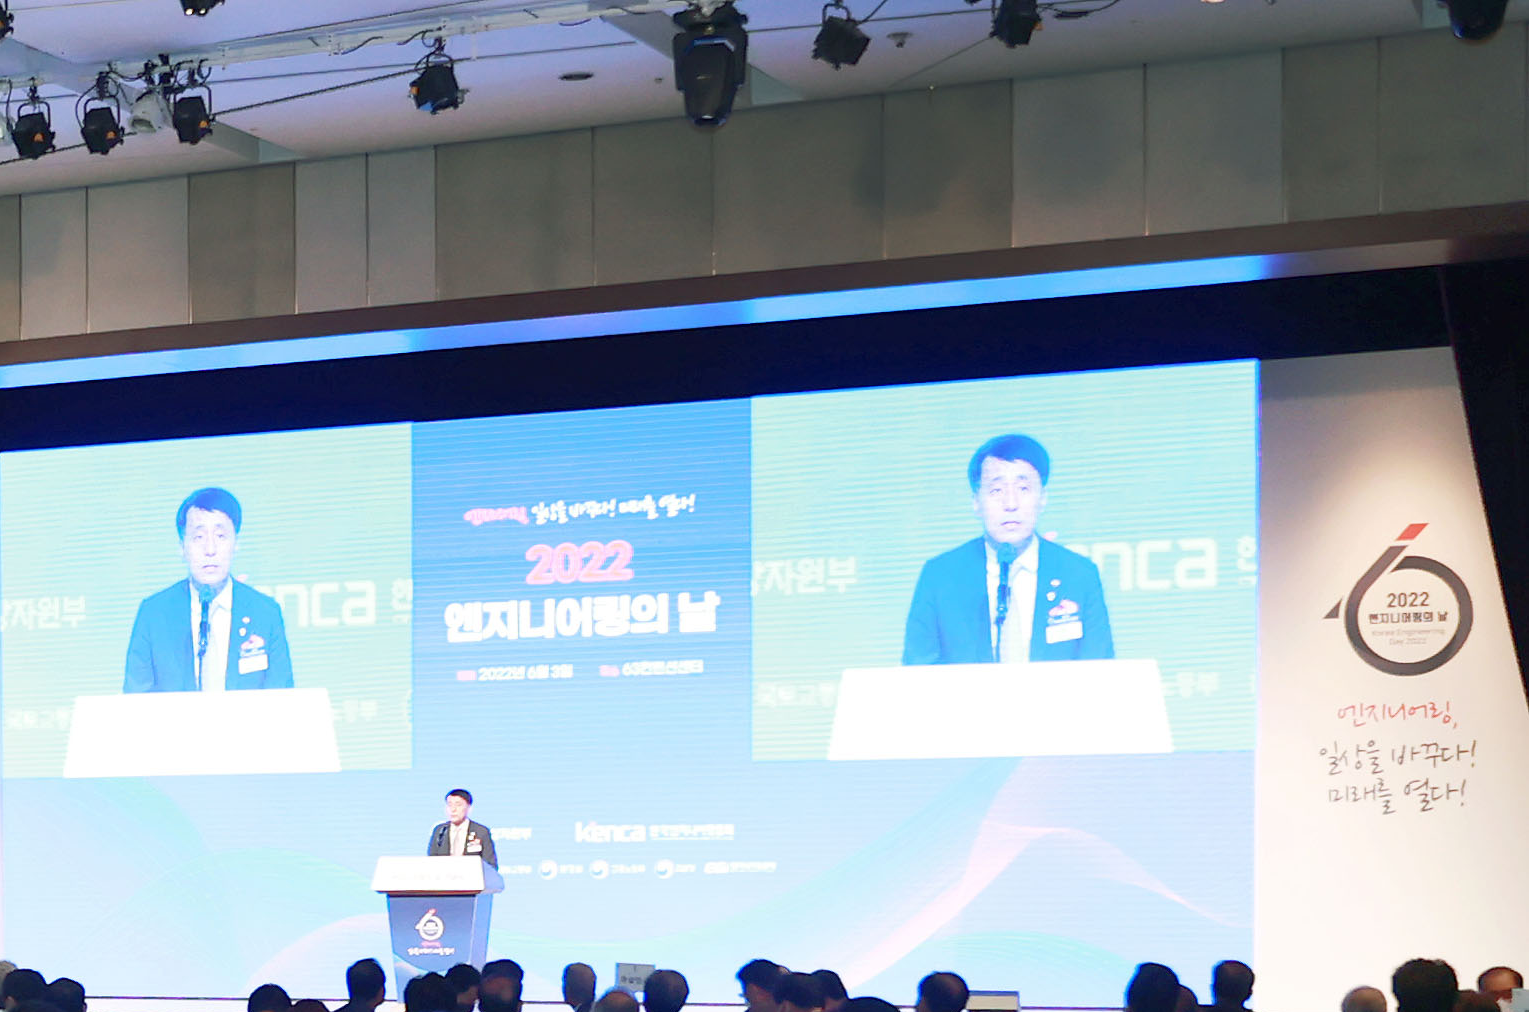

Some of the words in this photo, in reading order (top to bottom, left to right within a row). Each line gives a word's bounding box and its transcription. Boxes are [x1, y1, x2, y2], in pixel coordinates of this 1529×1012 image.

[525, 540, 635, 586] 2022
[444, 594, 669, 643] 엔지니어링의
[677, 590, 721, 633] 날
[1386, 591, 1430, 608] 2022
[1337, 701, 1458, 729] 엔지니어링,
[1319, 739, 1384, 776] 일상을
[1391, 739, 1477, 768] 바꾸다!
[1328, 777, 1396, 815] 미래를
[1404, 778, 1467, 812] 열다!
